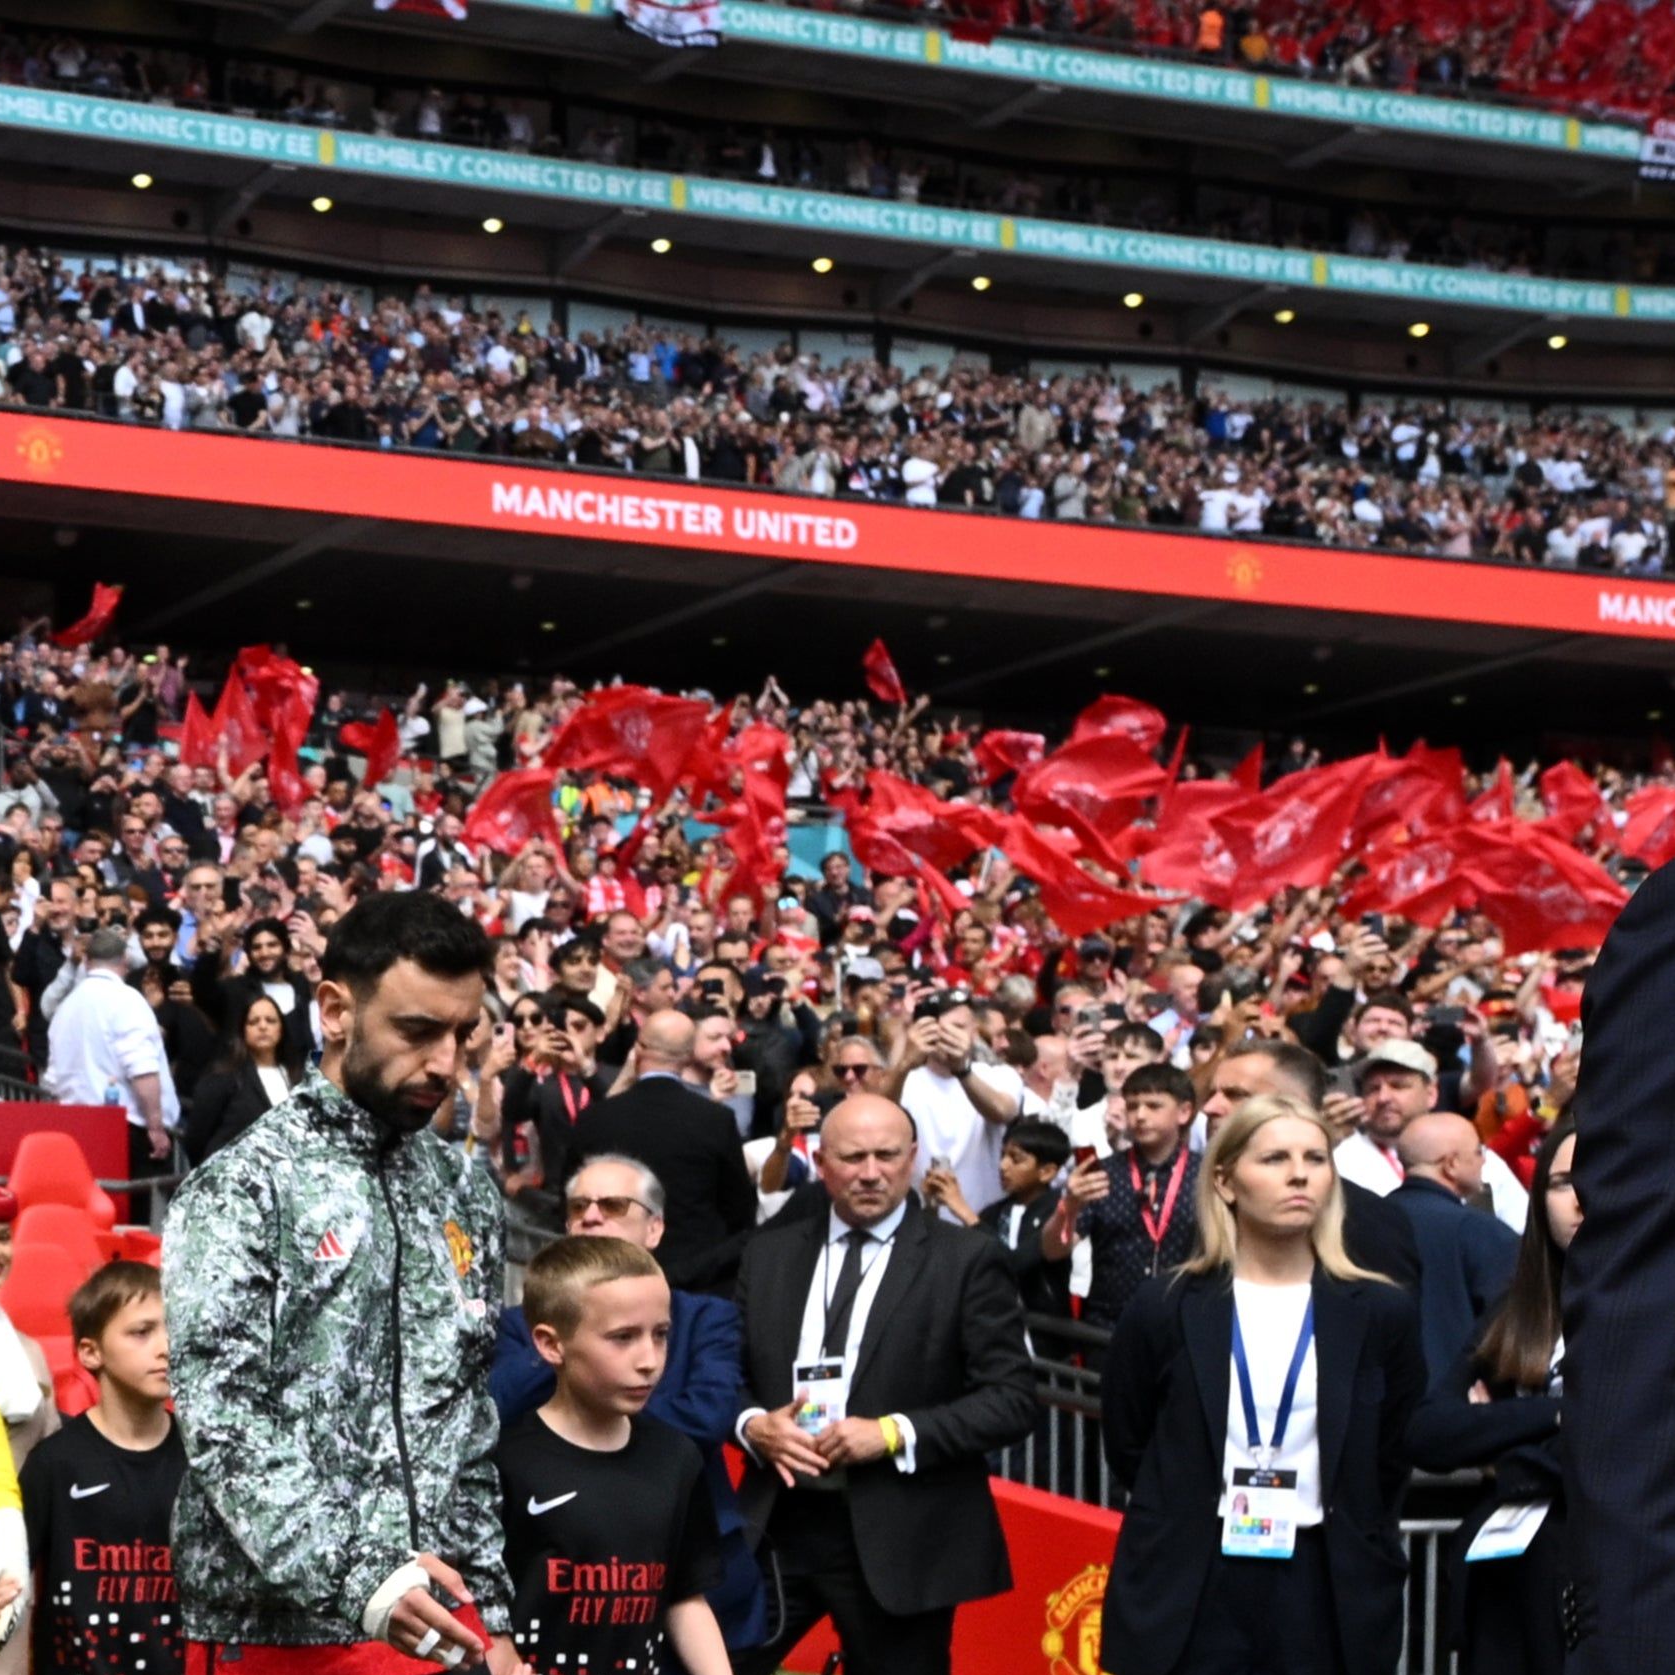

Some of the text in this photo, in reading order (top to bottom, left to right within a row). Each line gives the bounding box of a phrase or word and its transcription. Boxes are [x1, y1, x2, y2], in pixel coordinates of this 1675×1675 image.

[92, 106, 245, 147] CONNECTED
[340, 141, 454, 172] WEMBLEY
[458, 155, 603, 193] CONNECTED
[491, 481, 858, 549] MANCHESTER UNITED
[73, 1537, 171, 1572] Emira
[96, 1577, 130, 1603] FLY
[569, 1597, 606, 1625] FLY
